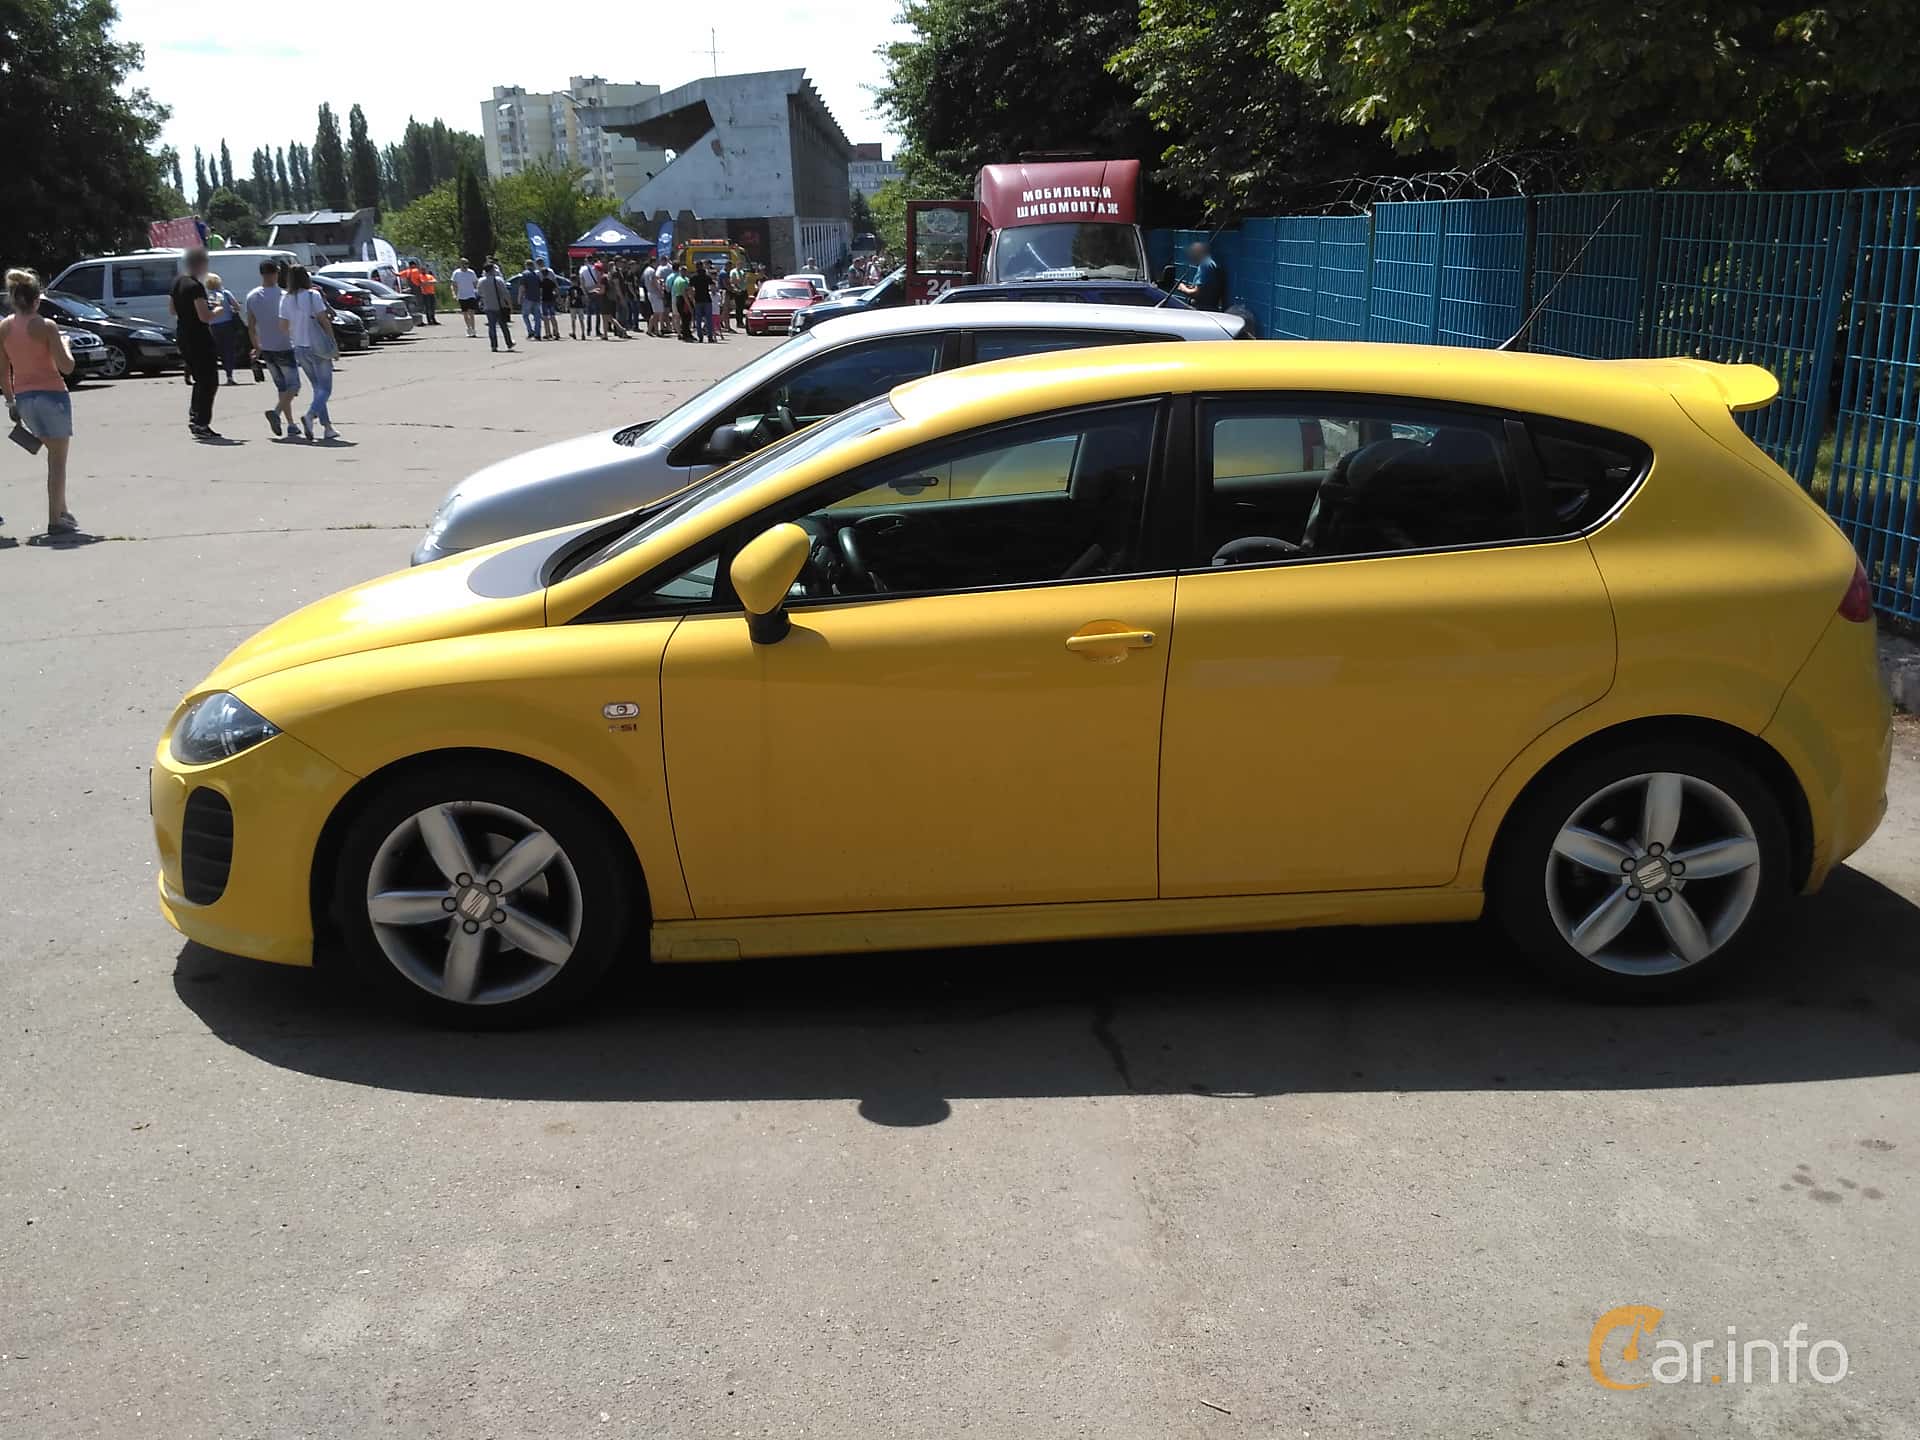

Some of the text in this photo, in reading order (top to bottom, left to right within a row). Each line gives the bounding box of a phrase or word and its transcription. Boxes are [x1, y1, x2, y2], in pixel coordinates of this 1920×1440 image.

[1023, 186, 1112, 202] МОБИЛЬНЫЙ
[1016, 201, 1119, 218] ШИНОМОНТАЖ
[927, 279, 951, 296] 24
